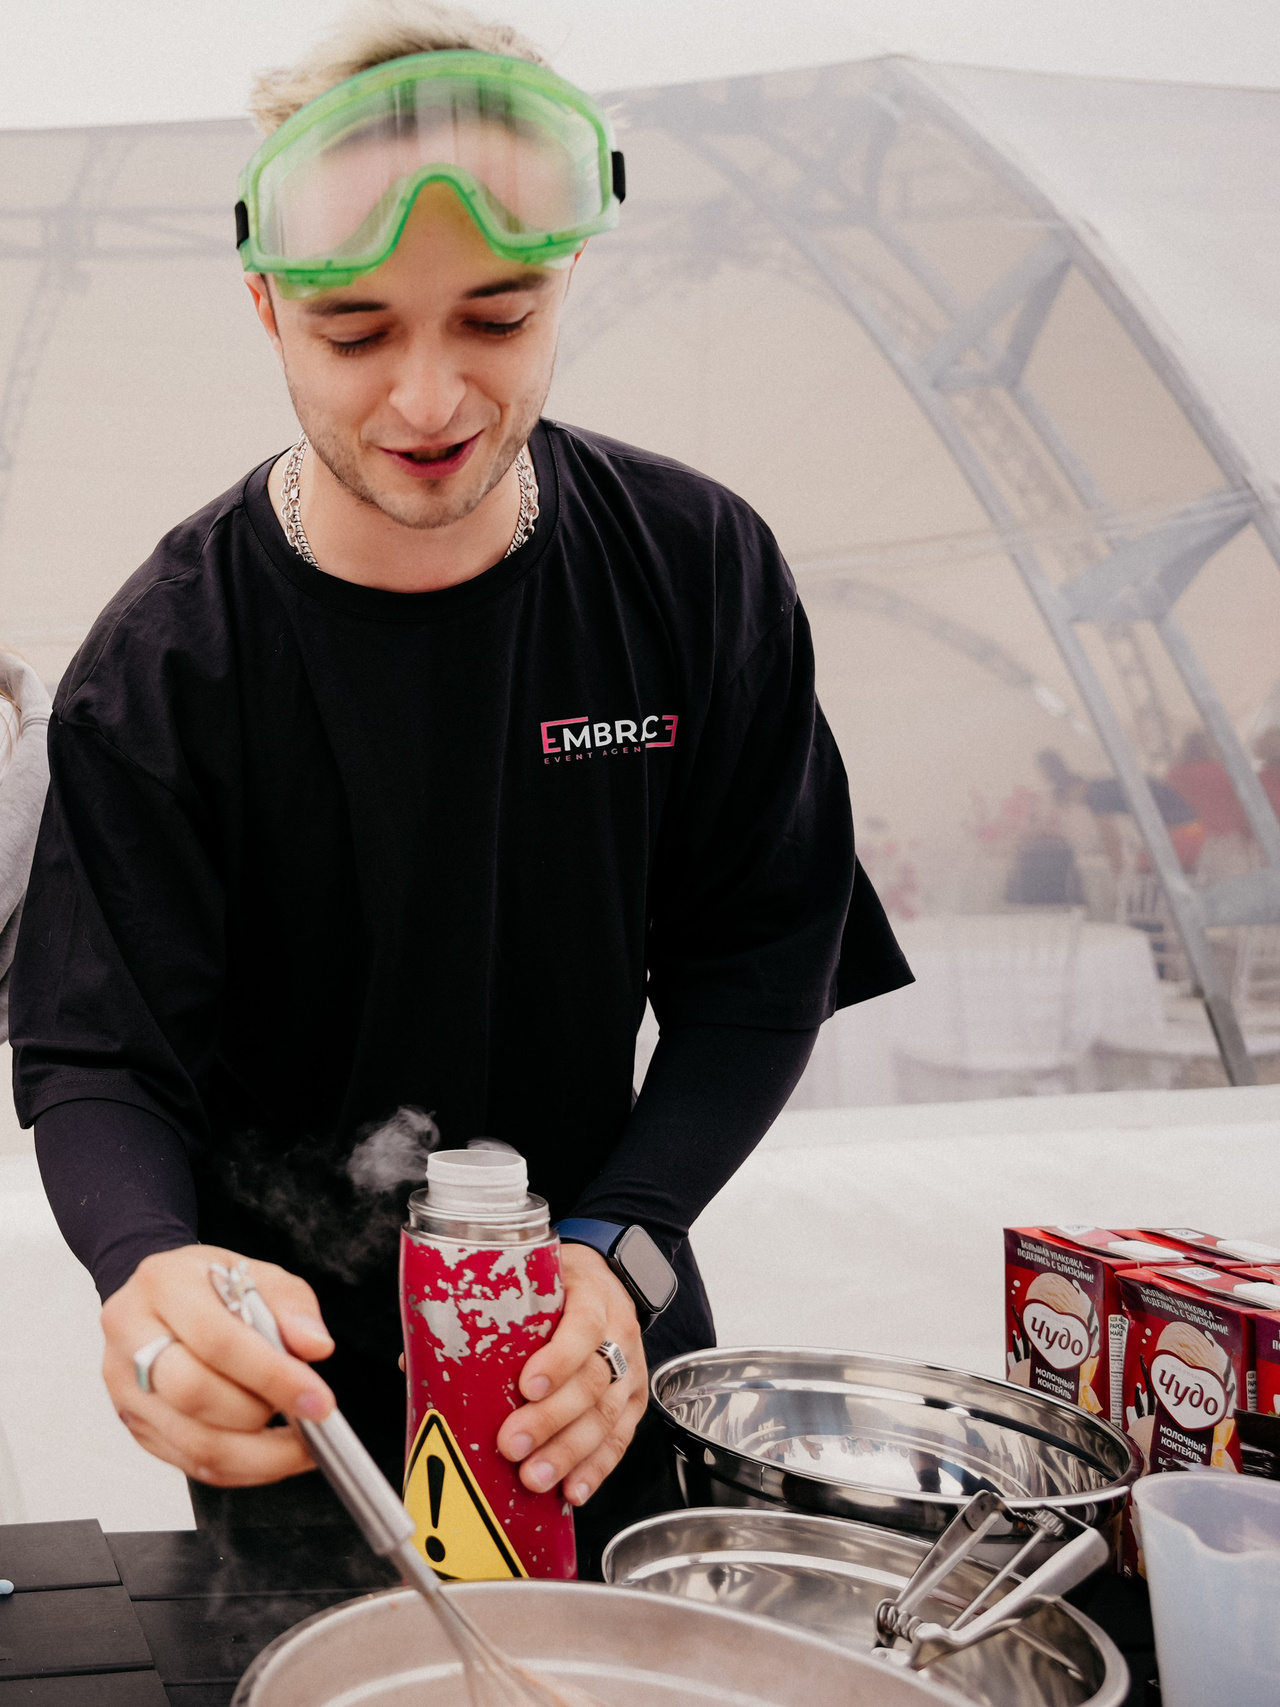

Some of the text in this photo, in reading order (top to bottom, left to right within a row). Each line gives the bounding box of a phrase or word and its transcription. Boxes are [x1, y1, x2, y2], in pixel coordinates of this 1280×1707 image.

[540, 715, 679, 754] EMBRCE
[543, 751, 593, 765] EVENT
[1017, 1248, 1051, 1268] ПОДЕЛИСЬ
[1056, 1262, 1095, 1284] БЛИЗКИМИ!
[1020, 1239, 1050, 1258] БОЛЬШАЯ
[1050, 1250, 1083, 1270] УПАКОВКА
[1140, 1286, 1176, 1305] БОЛЬШАЯ
[1175, 1298, 1215, 1321] УПАКОВКА
[1140, 1294, 1179, 1316] ПОДЕЛИСЬ
[1185, 1311, 1229, 1336] БЛИЗКИМИ!
[1035, 1366, 1075, 1392] МОЛОЧНЫЙ
[1037, 1377, 1072, 1400] КОКТЕЙЛЬ
[1159, 1424, 1207, 1455] МОЛОЧНЫЙ
[1160, 1436, 1202, 1463] КОКТЕЙЛЬ
